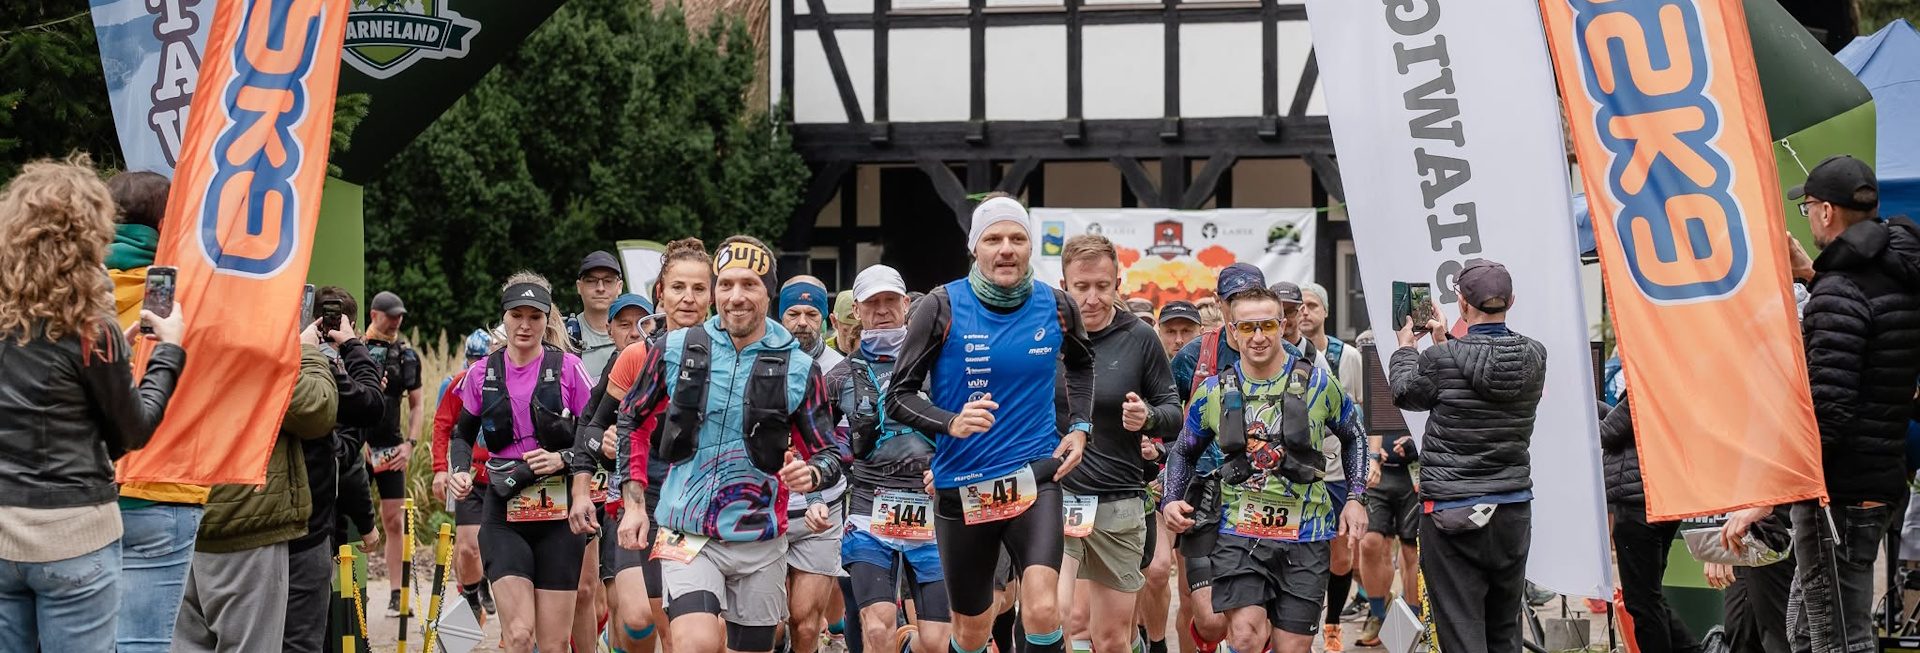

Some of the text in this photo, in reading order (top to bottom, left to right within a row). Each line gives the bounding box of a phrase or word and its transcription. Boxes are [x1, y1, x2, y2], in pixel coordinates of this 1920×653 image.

[345, 20, 440, 43] ARNELAND
[537, 487, 548, 508] 1
[992, 476, 1018, 504] 47
[891, 503, 927, 527] 144
[1261, 505, 1289, 528] 33
